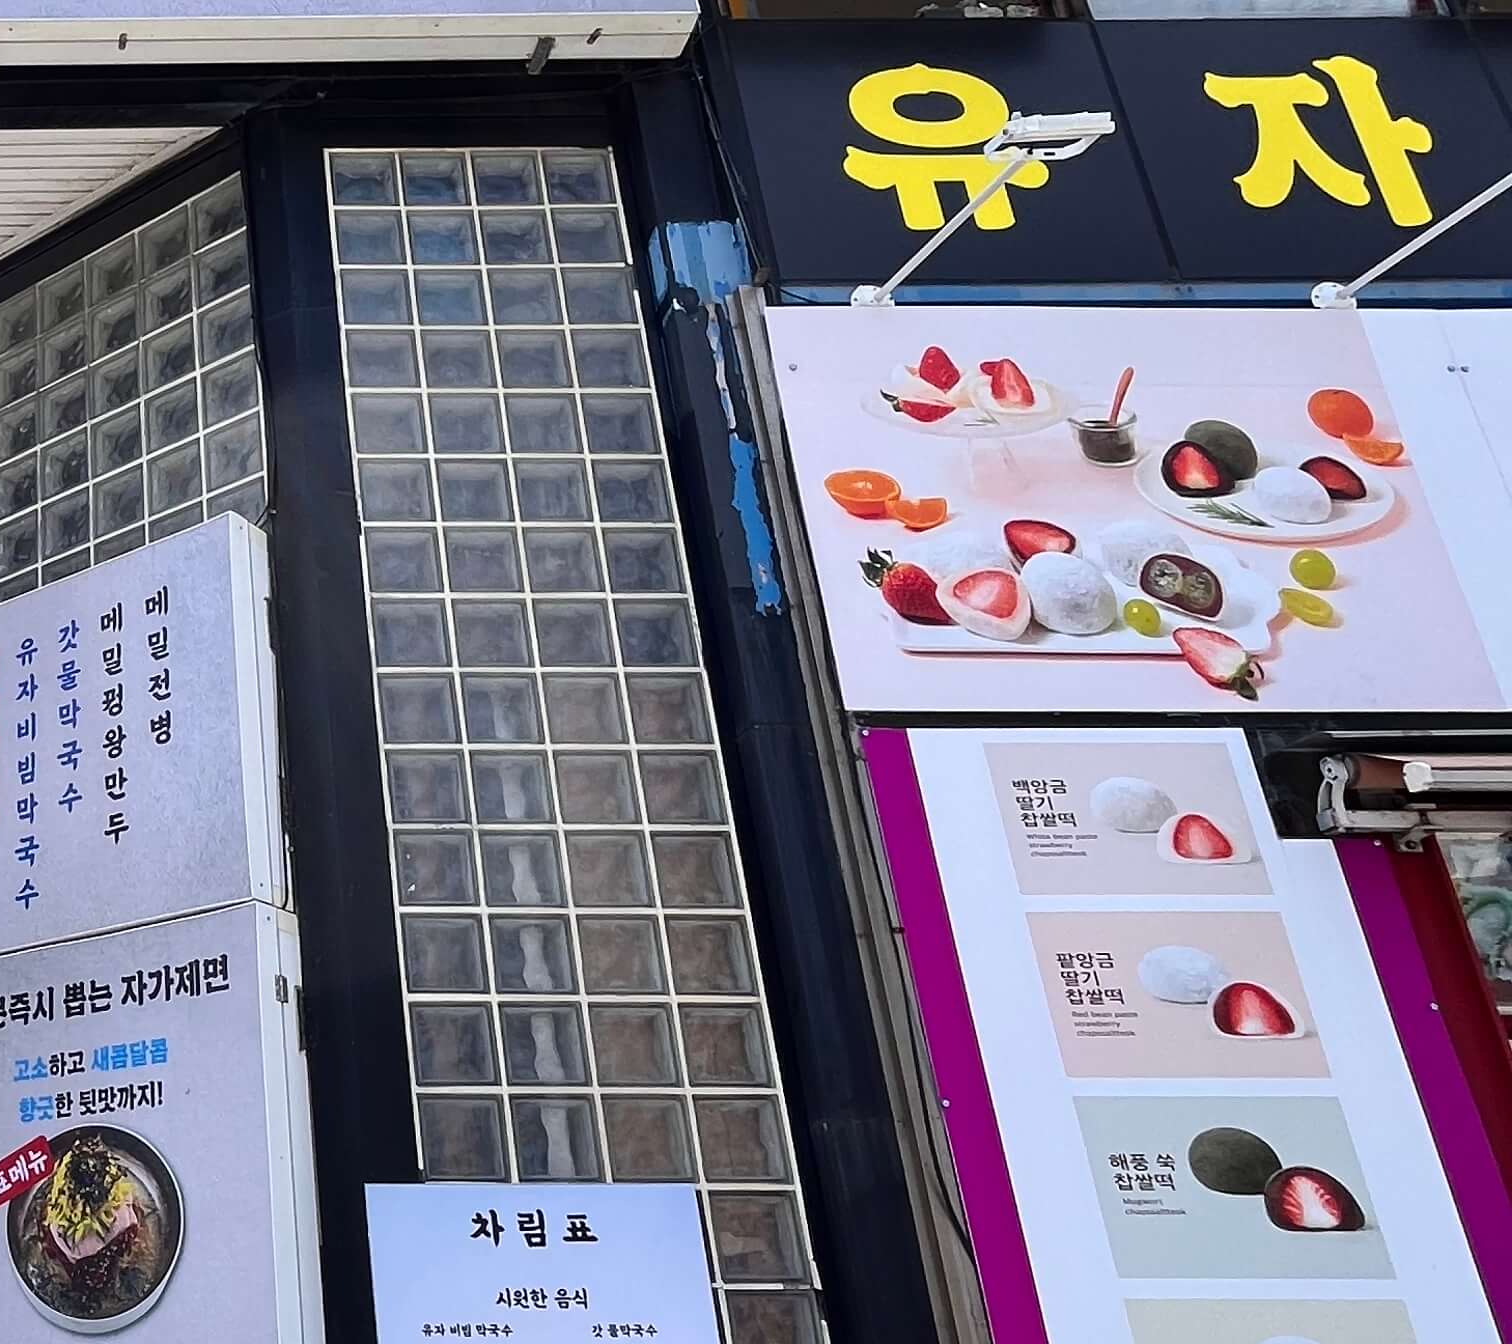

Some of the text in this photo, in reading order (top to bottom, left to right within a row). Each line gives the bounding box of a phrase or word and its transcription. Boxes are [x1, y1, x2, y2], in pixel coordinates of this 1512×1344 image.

[844, 55, 1433, 230] 유자
[145, 585, 173, 746] 메밀전병
[57, 619, 83, 814] 갓물막국수
[15, 638, 39, 910] 유자비빔막국수
[1011, 779, 1067, 794] 백앙금
[1016, 796, 1054, 811] 딸기
[1020, 812, 1077, 828] 찹쌀떡
[1056, 952, 1115, 969] 팥앙금
[63, 979, 113, 1019] 뽑는
[120, 953, 232, 1008] 자가제면
[1060, 971, 1100, 987] 딸기
[1065, 988, 1125, 1006] 찹쌀떡
[13, 1037, 169, 1082] 고소하고 새콤달콤
[18, 1081, 164, 1123] 향긋한 뒷맛까지!
[1108, 1153, 1176, 1172] 해풍 쑥
[1113, 1172, 1177, 1192] 찹쌀떡
[469, 1209, 598, 1247] 차림표
[496, 1288, 589, 1310] 시원한 음식
[422, 1324, 445, 1338] 유자
[475, 1324, 513, 1338] 막국수
[592, 1324, 602, 1338] 갓
